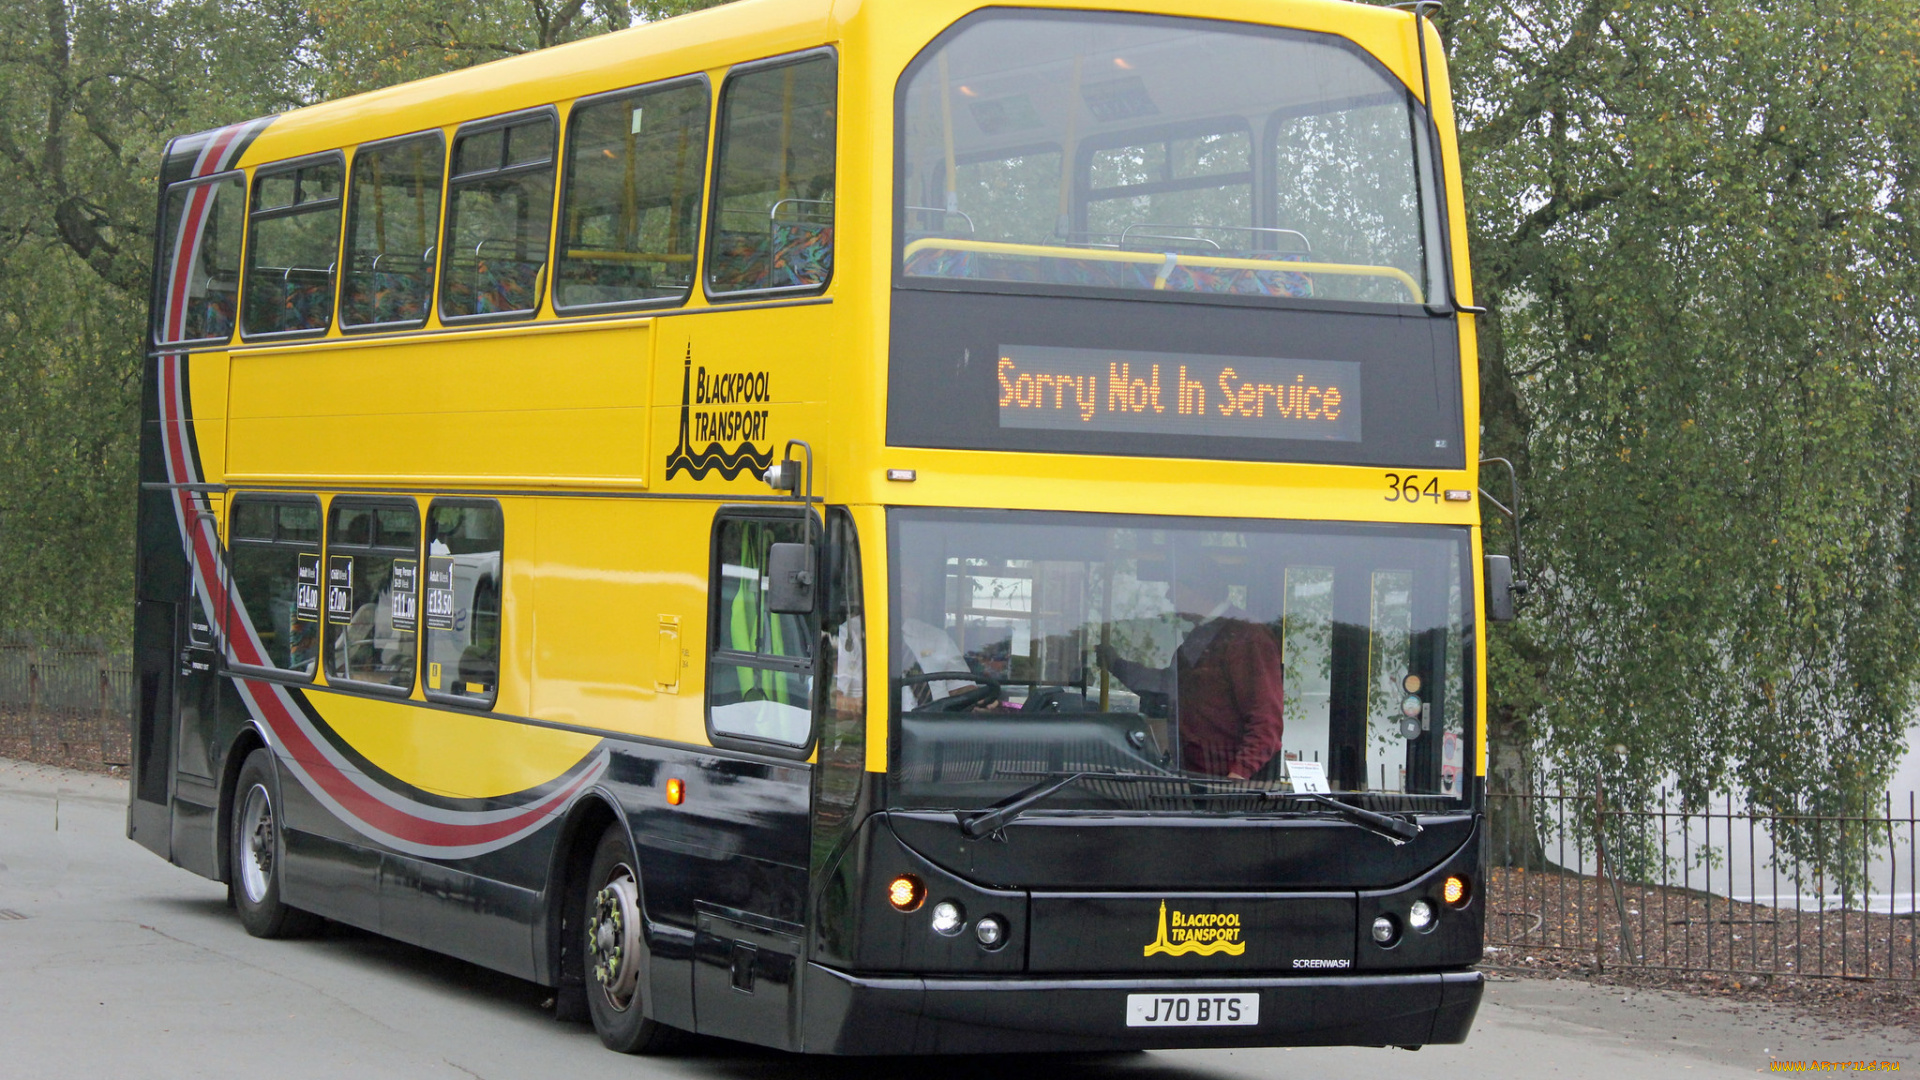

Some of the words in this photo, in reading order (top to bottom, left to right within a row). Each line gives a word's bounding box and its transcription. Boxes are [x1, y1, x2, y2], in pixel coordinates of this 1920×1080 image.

[695, 365, 770, 405] BLACKPOOL
[997, 356, 1096, 422] Sorry
[1108, 361, 1166, 414] Not
[1178, 364, 1206, 416] In
[1217, 366, 1343, 421] Service
[695, 410, 769, 442] TRANSPORT
[1384, 472, 1442, 504] 364
[429, 589, 452, 615] £13.50
[1171, 910, 1241, 927] BLACKPOOL
[1171, 928, 1241, 942] TRANSPORT
[1292, 959, 1351, 969] SCREENWASH
[1144, 998, 1190, 1022] J70
[1196, 998, 1242, 1022] BTS
